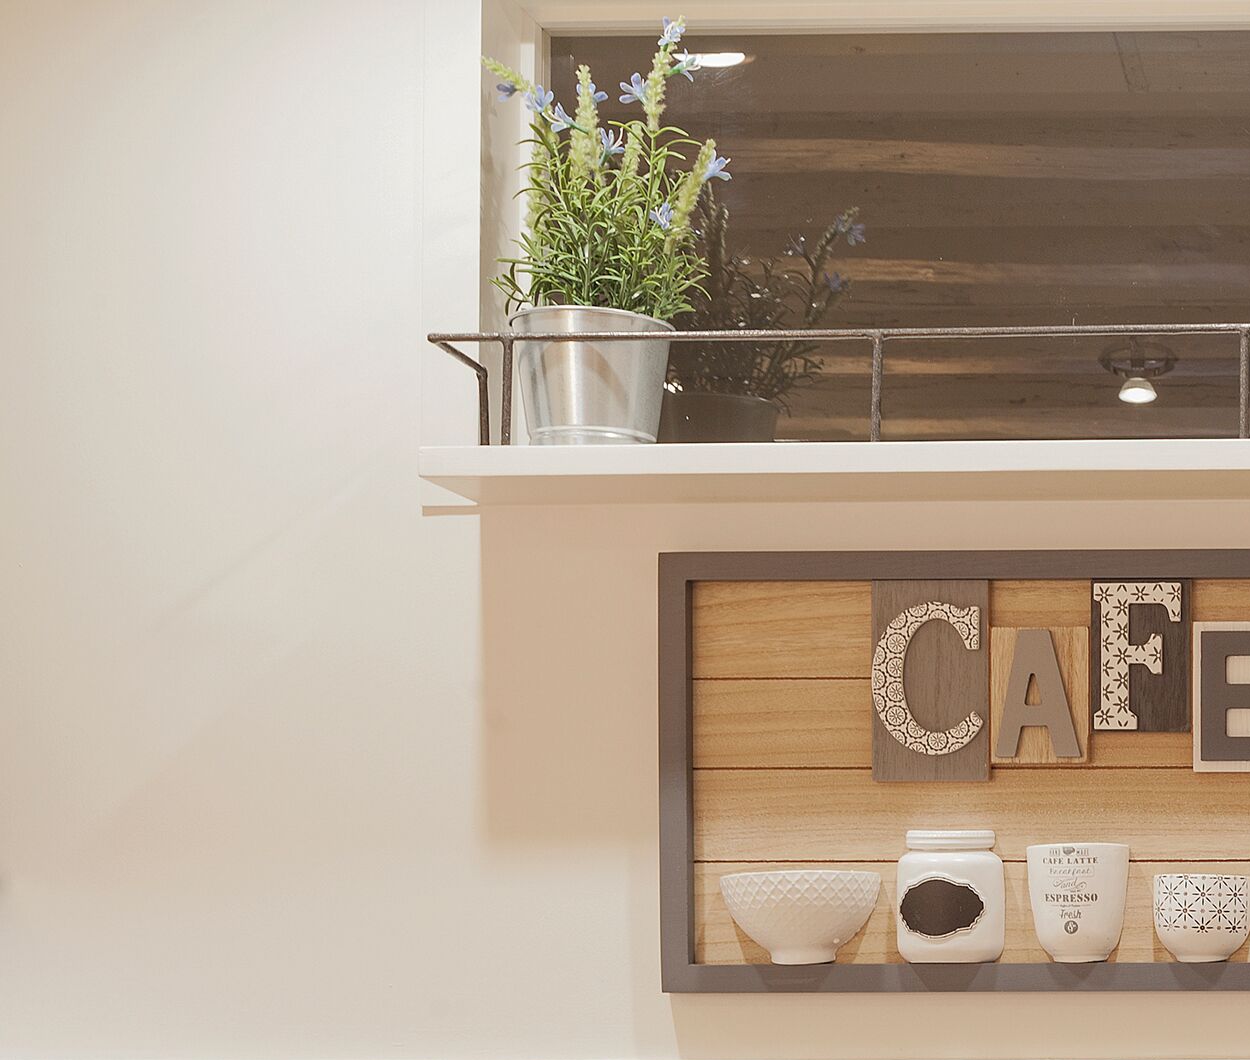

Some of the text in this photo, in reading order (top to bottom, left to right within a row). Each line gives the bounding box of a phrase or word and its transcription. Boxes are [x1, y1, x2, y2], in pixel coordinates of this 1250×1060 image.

[1043, 857, 1099, 865] CAFE LATTE
[1045, 893, 1098, 903] ESPRESSO
